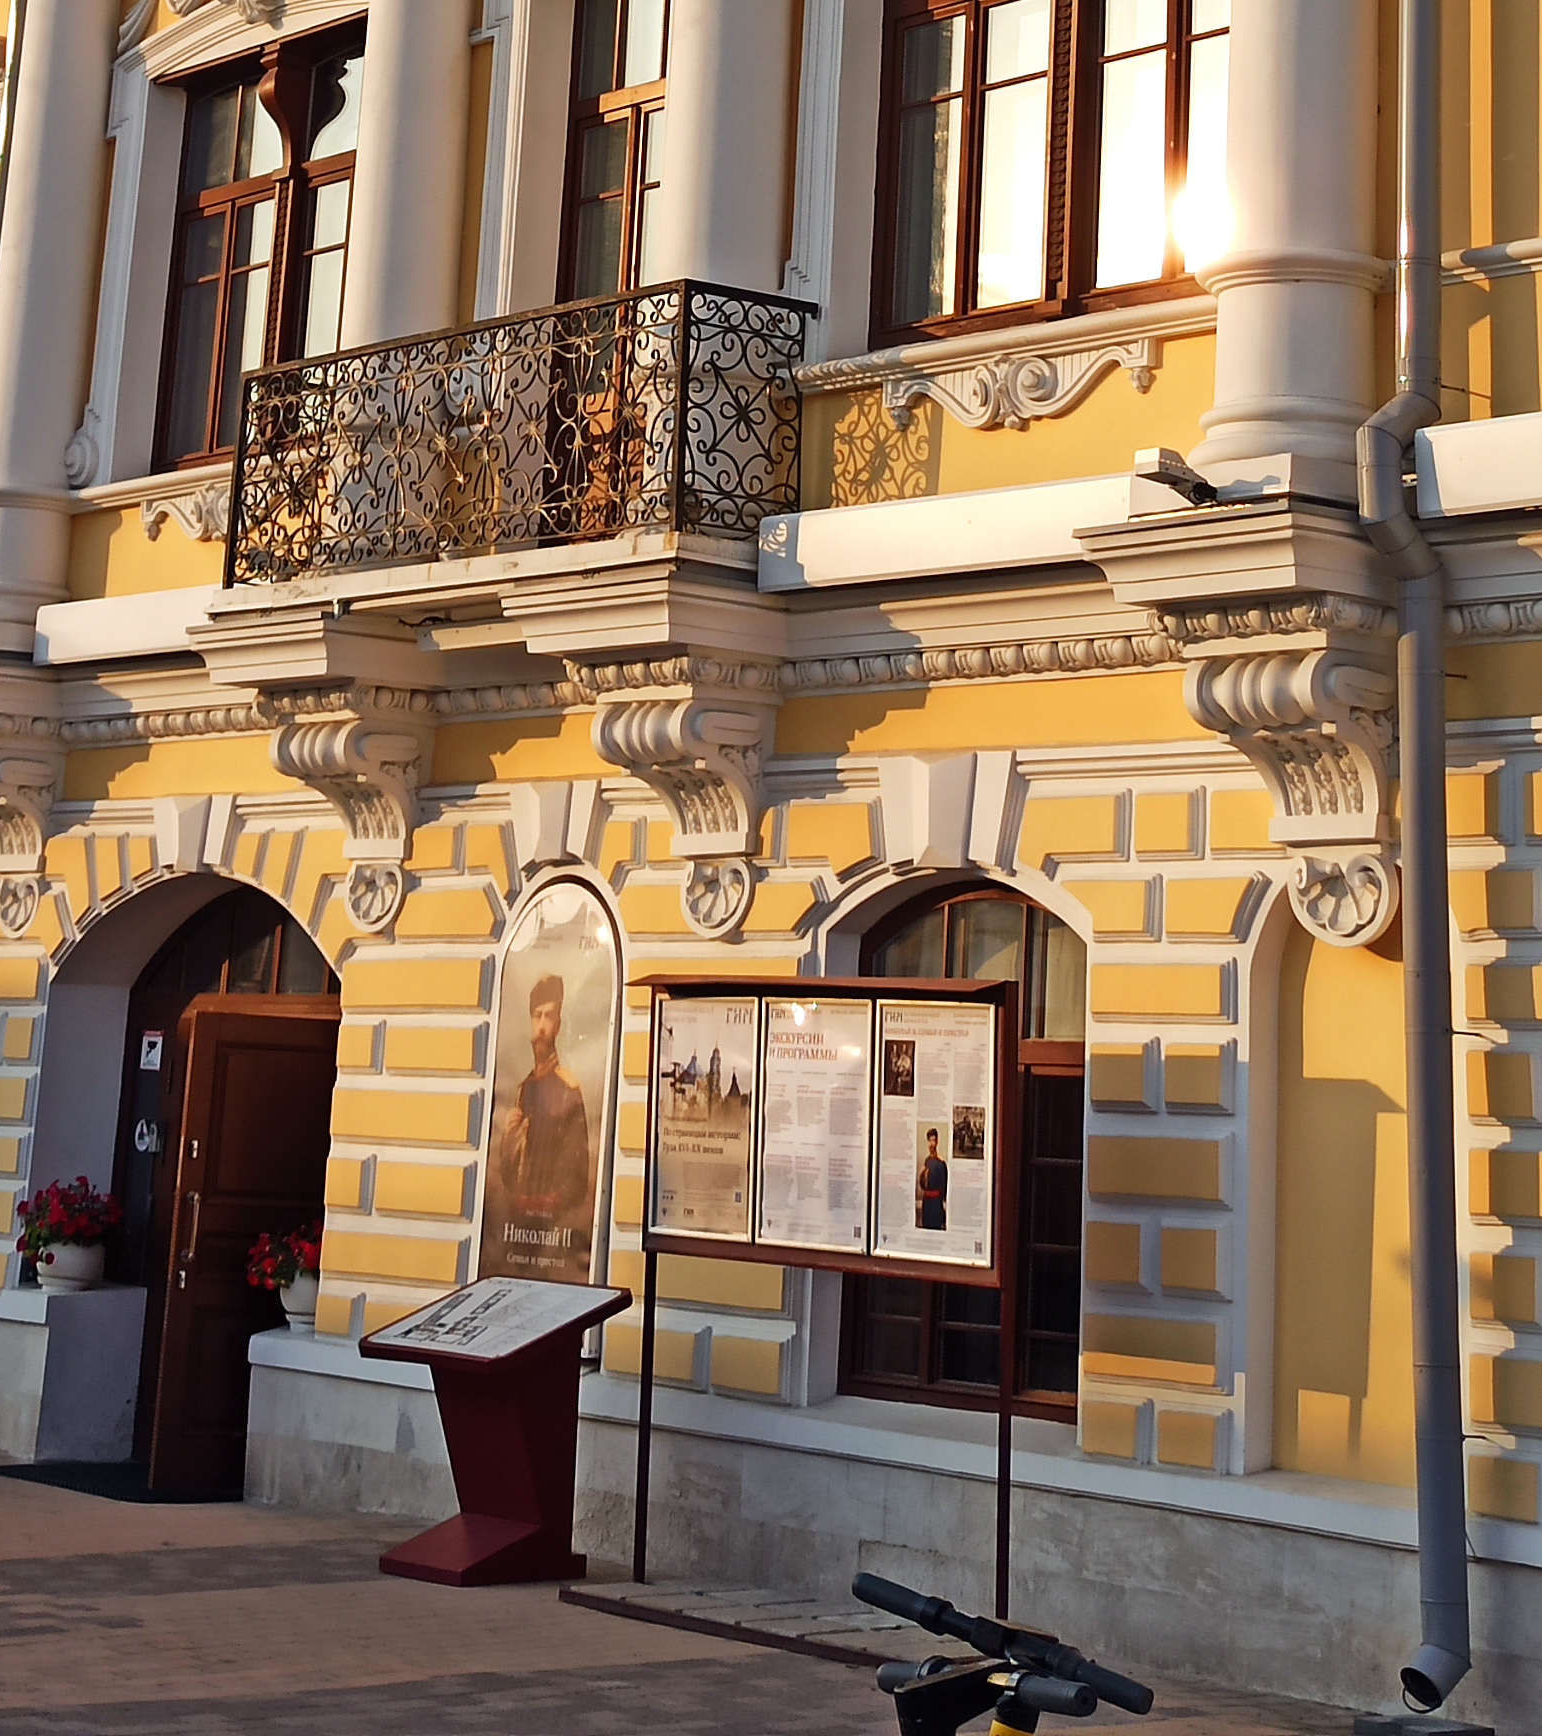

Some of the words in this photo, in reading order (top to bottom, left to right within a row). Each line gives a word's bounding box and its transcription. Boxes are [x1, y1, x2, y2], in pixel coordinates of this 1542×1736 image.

[726, 1007, 753, 1024] ГИМ
[884, 1011, 903, 1024] ГИМ
[770, 1032, 824, 1045] ЭКСКУРСИИ
[769, 1047, 775, 1058] И
[778, 1047, 838, 1061] ПРОГРАММЫ
[503, 1222, 560, 1247] Николай
[562, 1227, 572, 1248] II
[506, 1251, 530, 1264] Семья
[537, 1257, 565, 1269] престол
